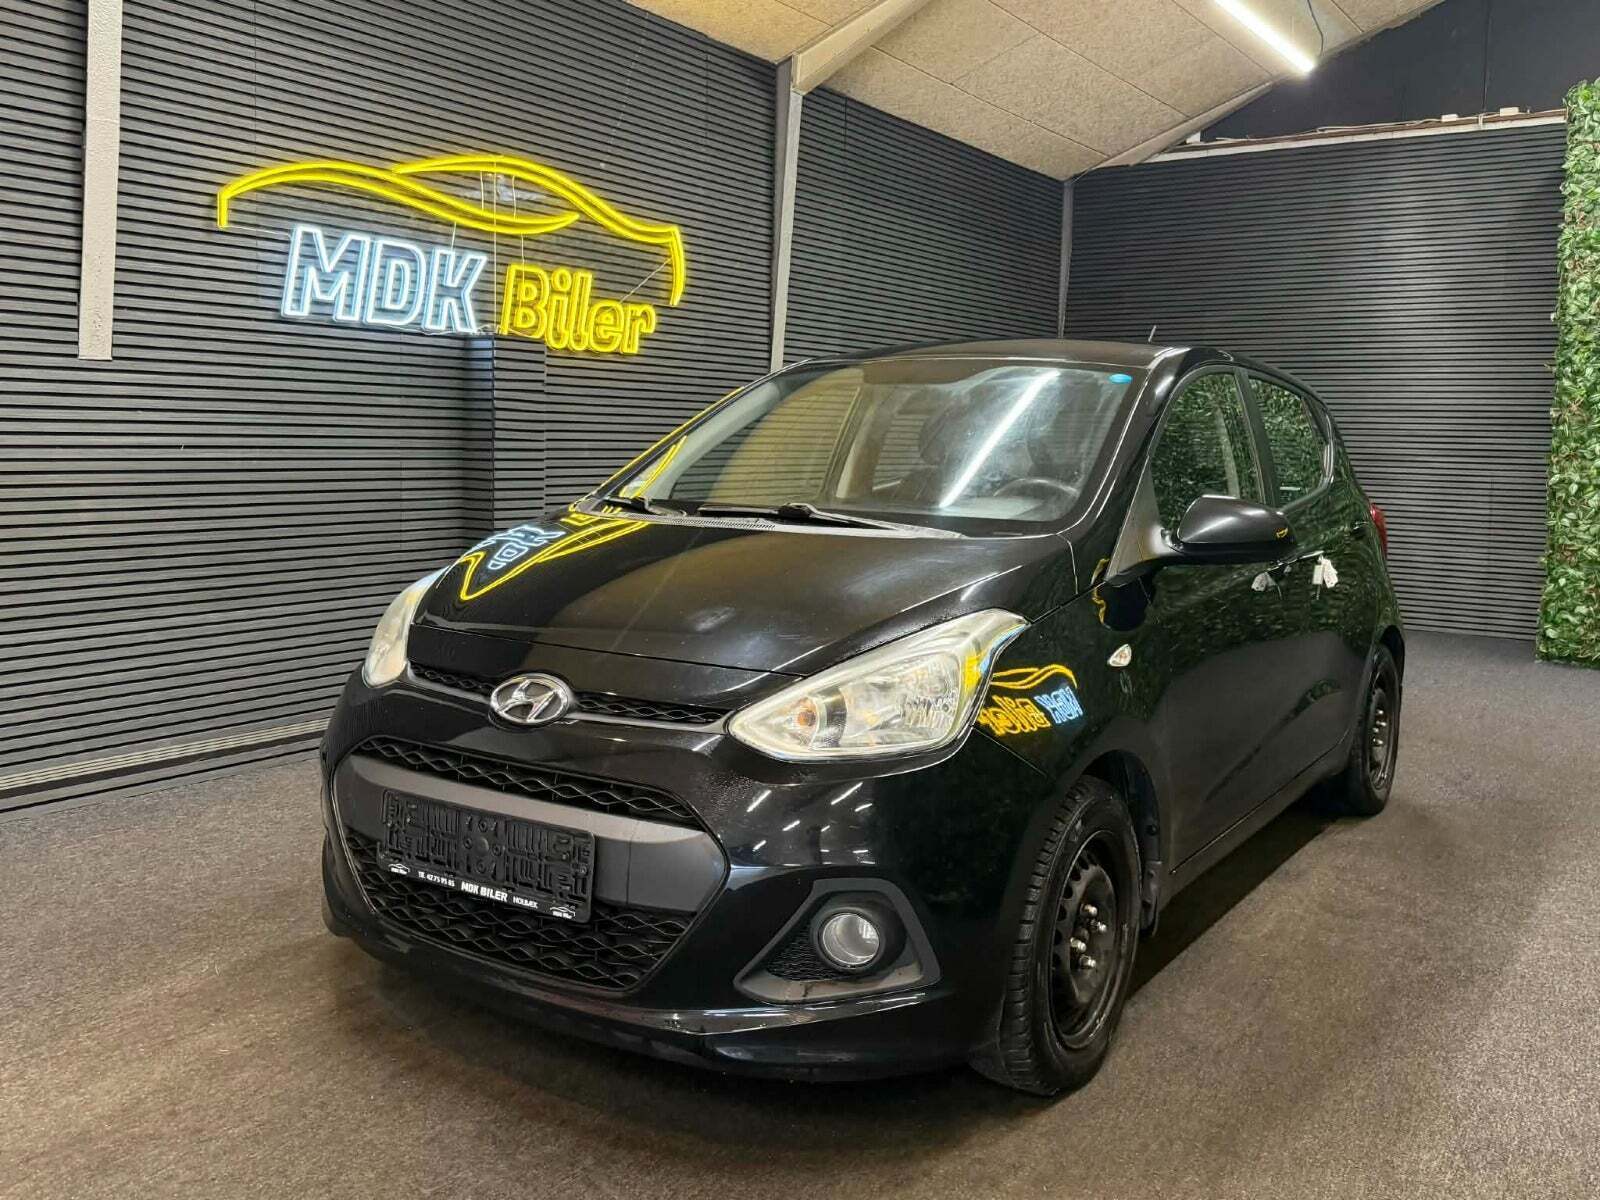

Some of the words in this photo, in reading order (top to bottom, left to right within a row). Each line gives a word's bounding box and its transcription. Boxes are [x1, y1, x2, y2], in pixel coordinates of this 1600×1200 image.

[281, 225, 488, 334] MDK
[500, 263, 657, 355] Biler
[461, 881, 479, 895] MDK
[480, 886, 508, 902] BILER
